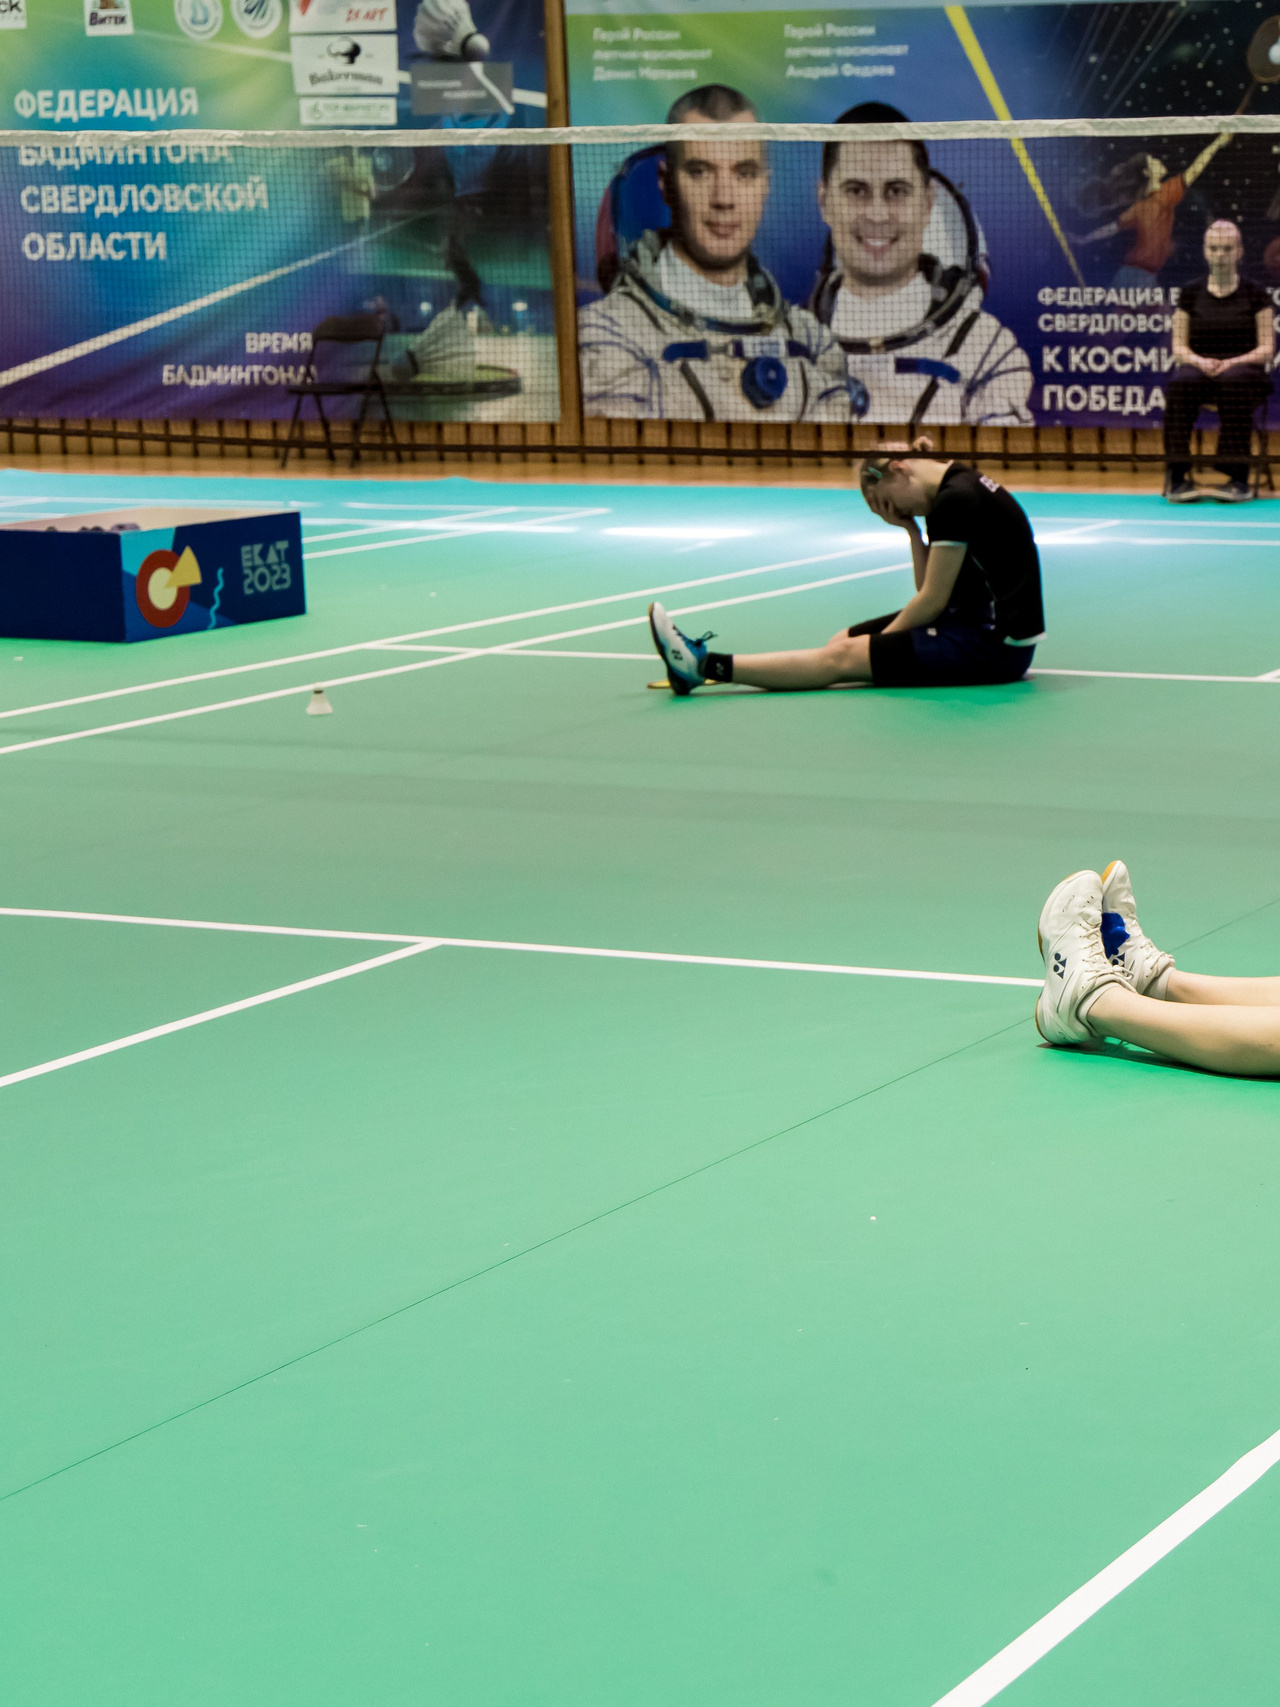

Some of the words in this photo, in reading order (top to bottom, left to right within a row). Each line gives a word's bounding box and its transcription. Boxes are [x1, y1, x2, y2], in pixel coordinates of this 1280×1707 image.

[14, 87, 199, 123] ФЕДЕРАЦИЯ
[20, 175, 269, 218] СВЕРДЛОВСКОЙ
[22, 231, 168, 261] ОБЛАСТИ
[1037, 286, 1164, 309] ФЕДЕРАЦИЯ
[245, 332, 313, 354] ВРЕМЯ
[1042, 345, 1064, 373] К
[241, 540, 289, 567] EKAT
[243, 563, 291, 595] 2023
